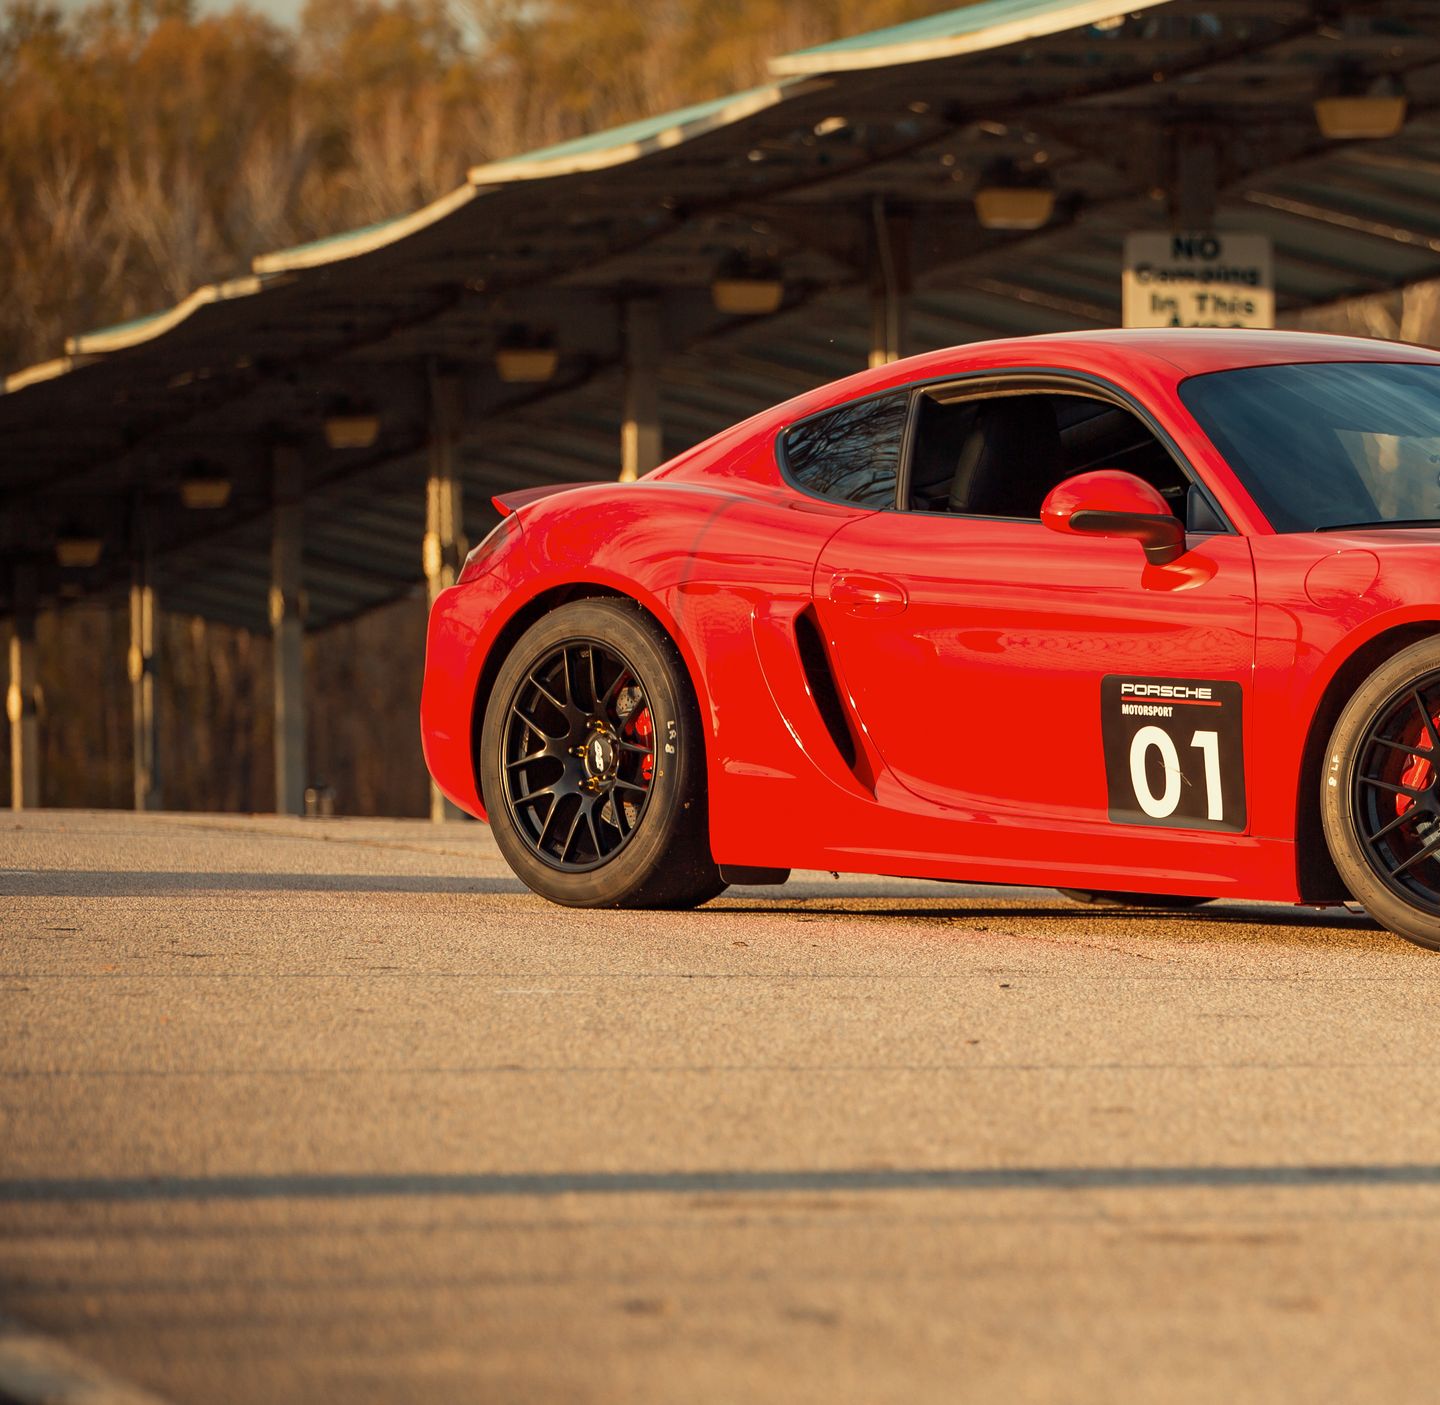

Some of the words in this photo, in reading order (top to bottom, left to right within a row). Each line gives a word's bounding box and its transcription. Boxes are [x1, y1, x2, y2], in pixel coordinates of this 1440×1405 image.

[1172, 236, 1221, 259] NO
[1151, 293, 1178, 313] In
[1194, 292, 1255, 314] This
[1121, 683, 1212, 699] PORSCHE
[1121, 704, 1173, 717] MOTORSPORT
[1129, 725, 1223, 821] 01
